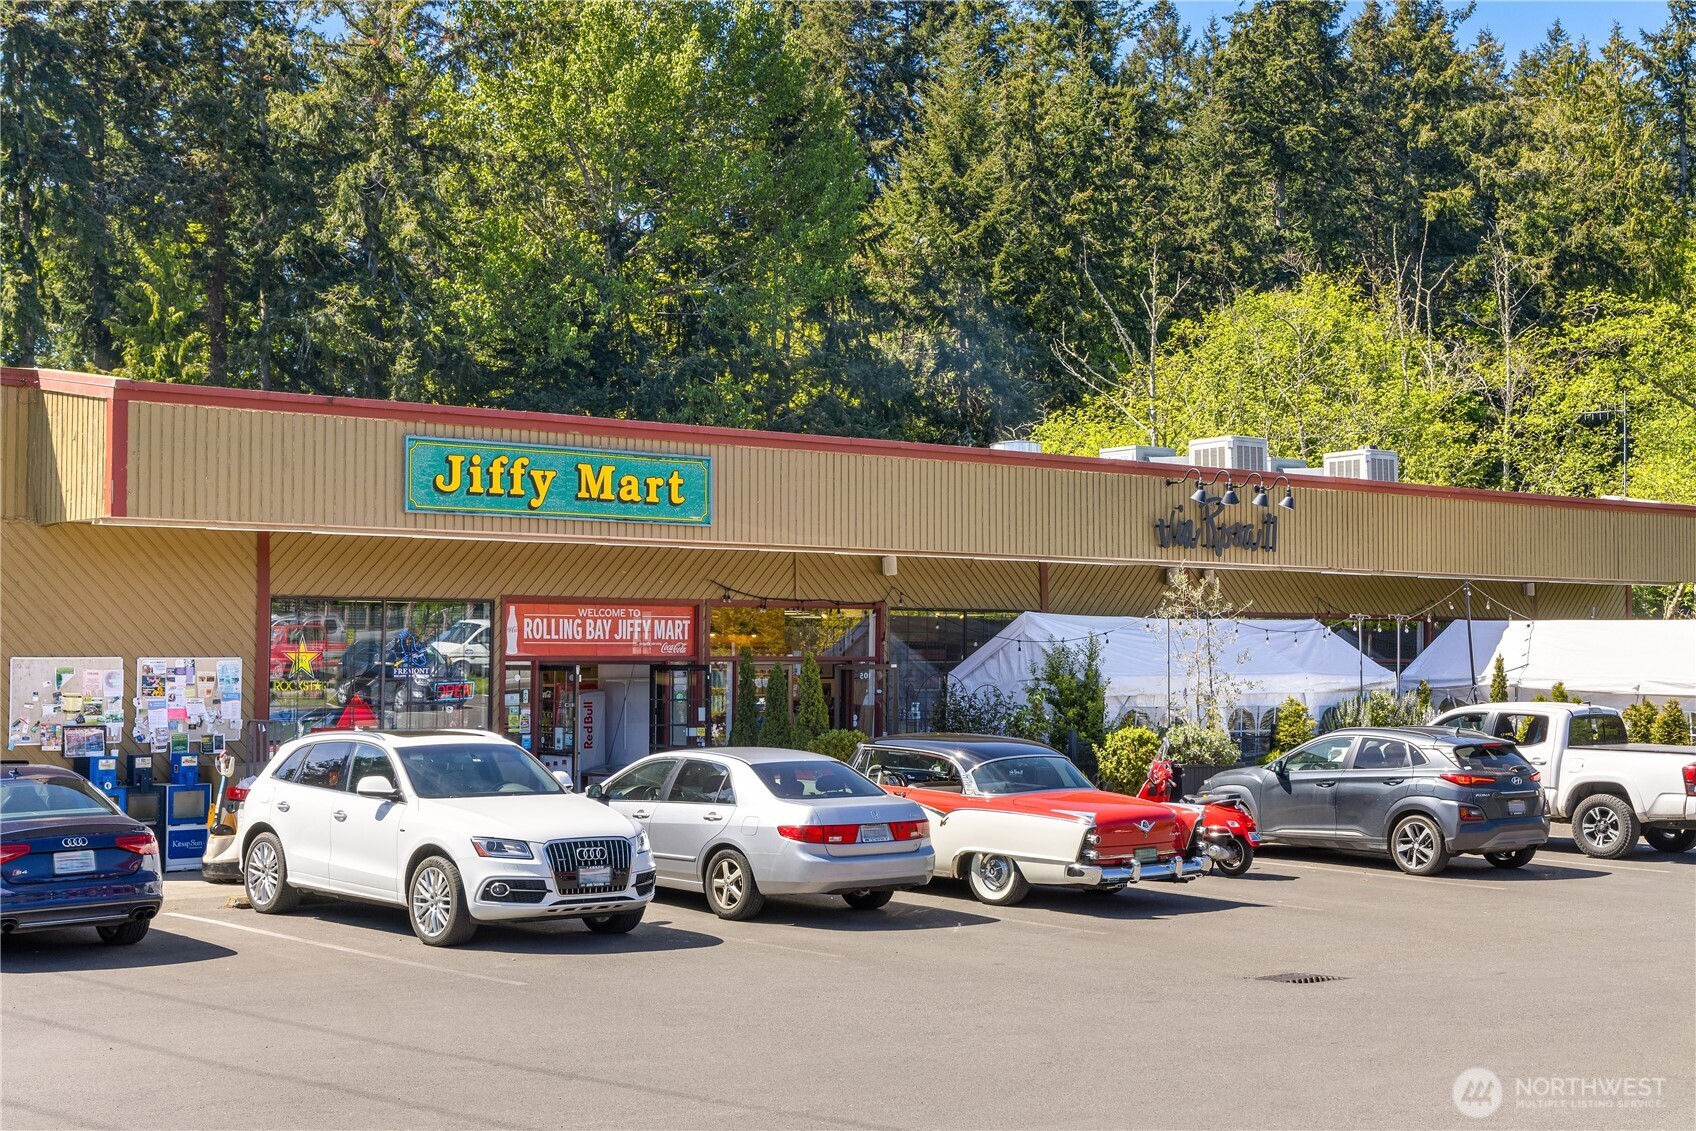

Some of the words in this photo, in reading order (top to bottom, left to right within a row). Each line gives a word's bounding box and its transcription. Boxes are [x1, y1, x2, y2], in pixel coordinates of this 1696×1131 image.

[434, 454, 557, 509] Jiffy
[576, 463, 686, 504] Mart
[578, 608, 626, 618] WELCOME
[628, 609, 641, 618] TO
[523, 618, 582, 639] ROLLING
[585, 619, 611, 640] BAY
[614, 619, 652, 640] JIFFY
[654, 620, 690, 640] MART
[437, 684, 473, 699] OPEN
[583, 701, 594, 725] Bull
[583, 725, 594, 750] Red
[190, 839, 203, 847] Sun
